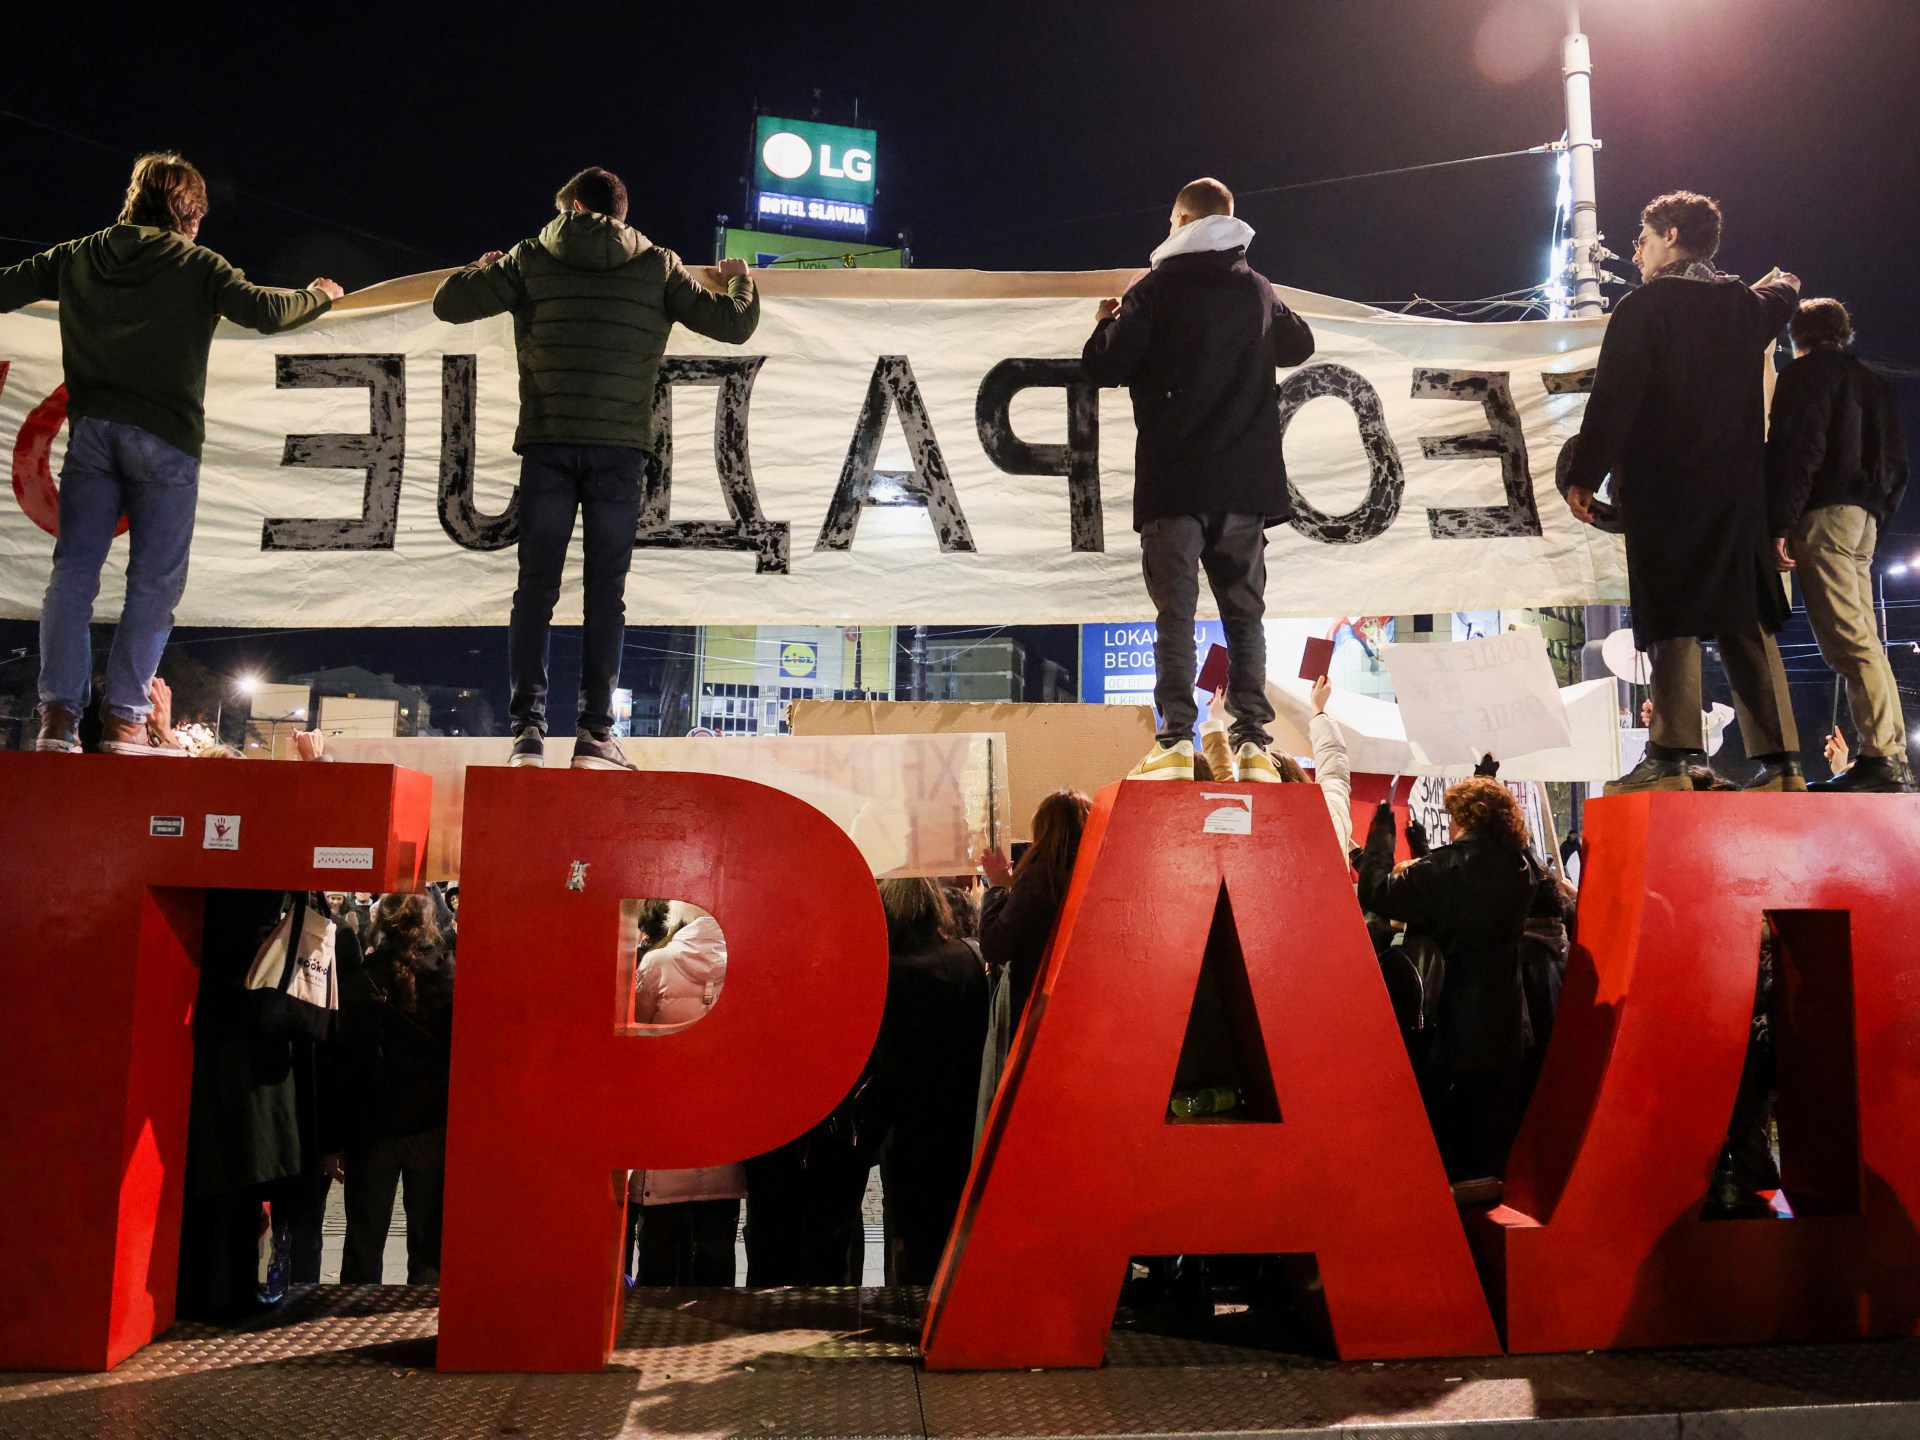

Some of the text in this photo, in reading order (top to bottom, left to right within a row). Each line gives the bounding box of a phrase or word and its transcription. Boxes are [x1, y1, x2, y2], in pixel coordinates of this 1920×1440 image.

[820, 144, 872, 182] LG
[760, 197, 866, 224] HOTEL SLAVIJA
[1108, 679, 1124, 689] OD
